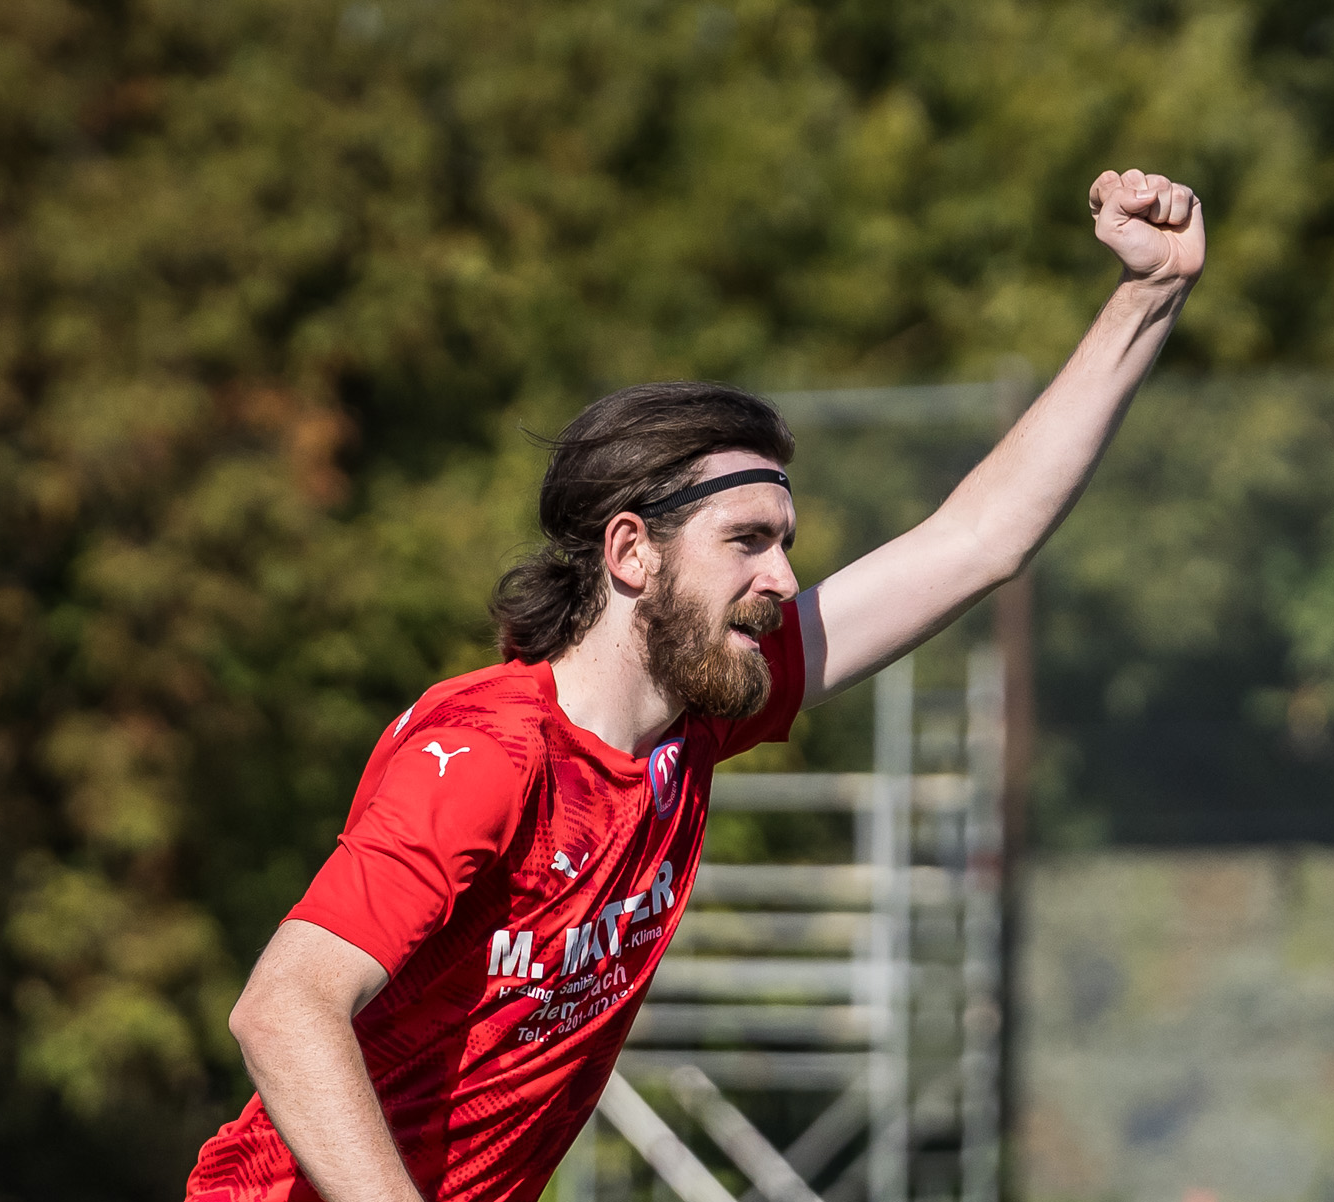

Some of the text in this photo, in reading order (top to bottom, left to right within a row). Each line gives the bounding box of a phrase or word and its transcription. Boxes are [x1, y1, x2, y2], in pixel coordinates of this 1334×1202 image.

[487, 860, 675, 979] M. MATZR
[498, 986, 555, 1004] Hzung
[631, 926, 663, 948] Klima
[517, 1027, 552, 1043] Tel.:
